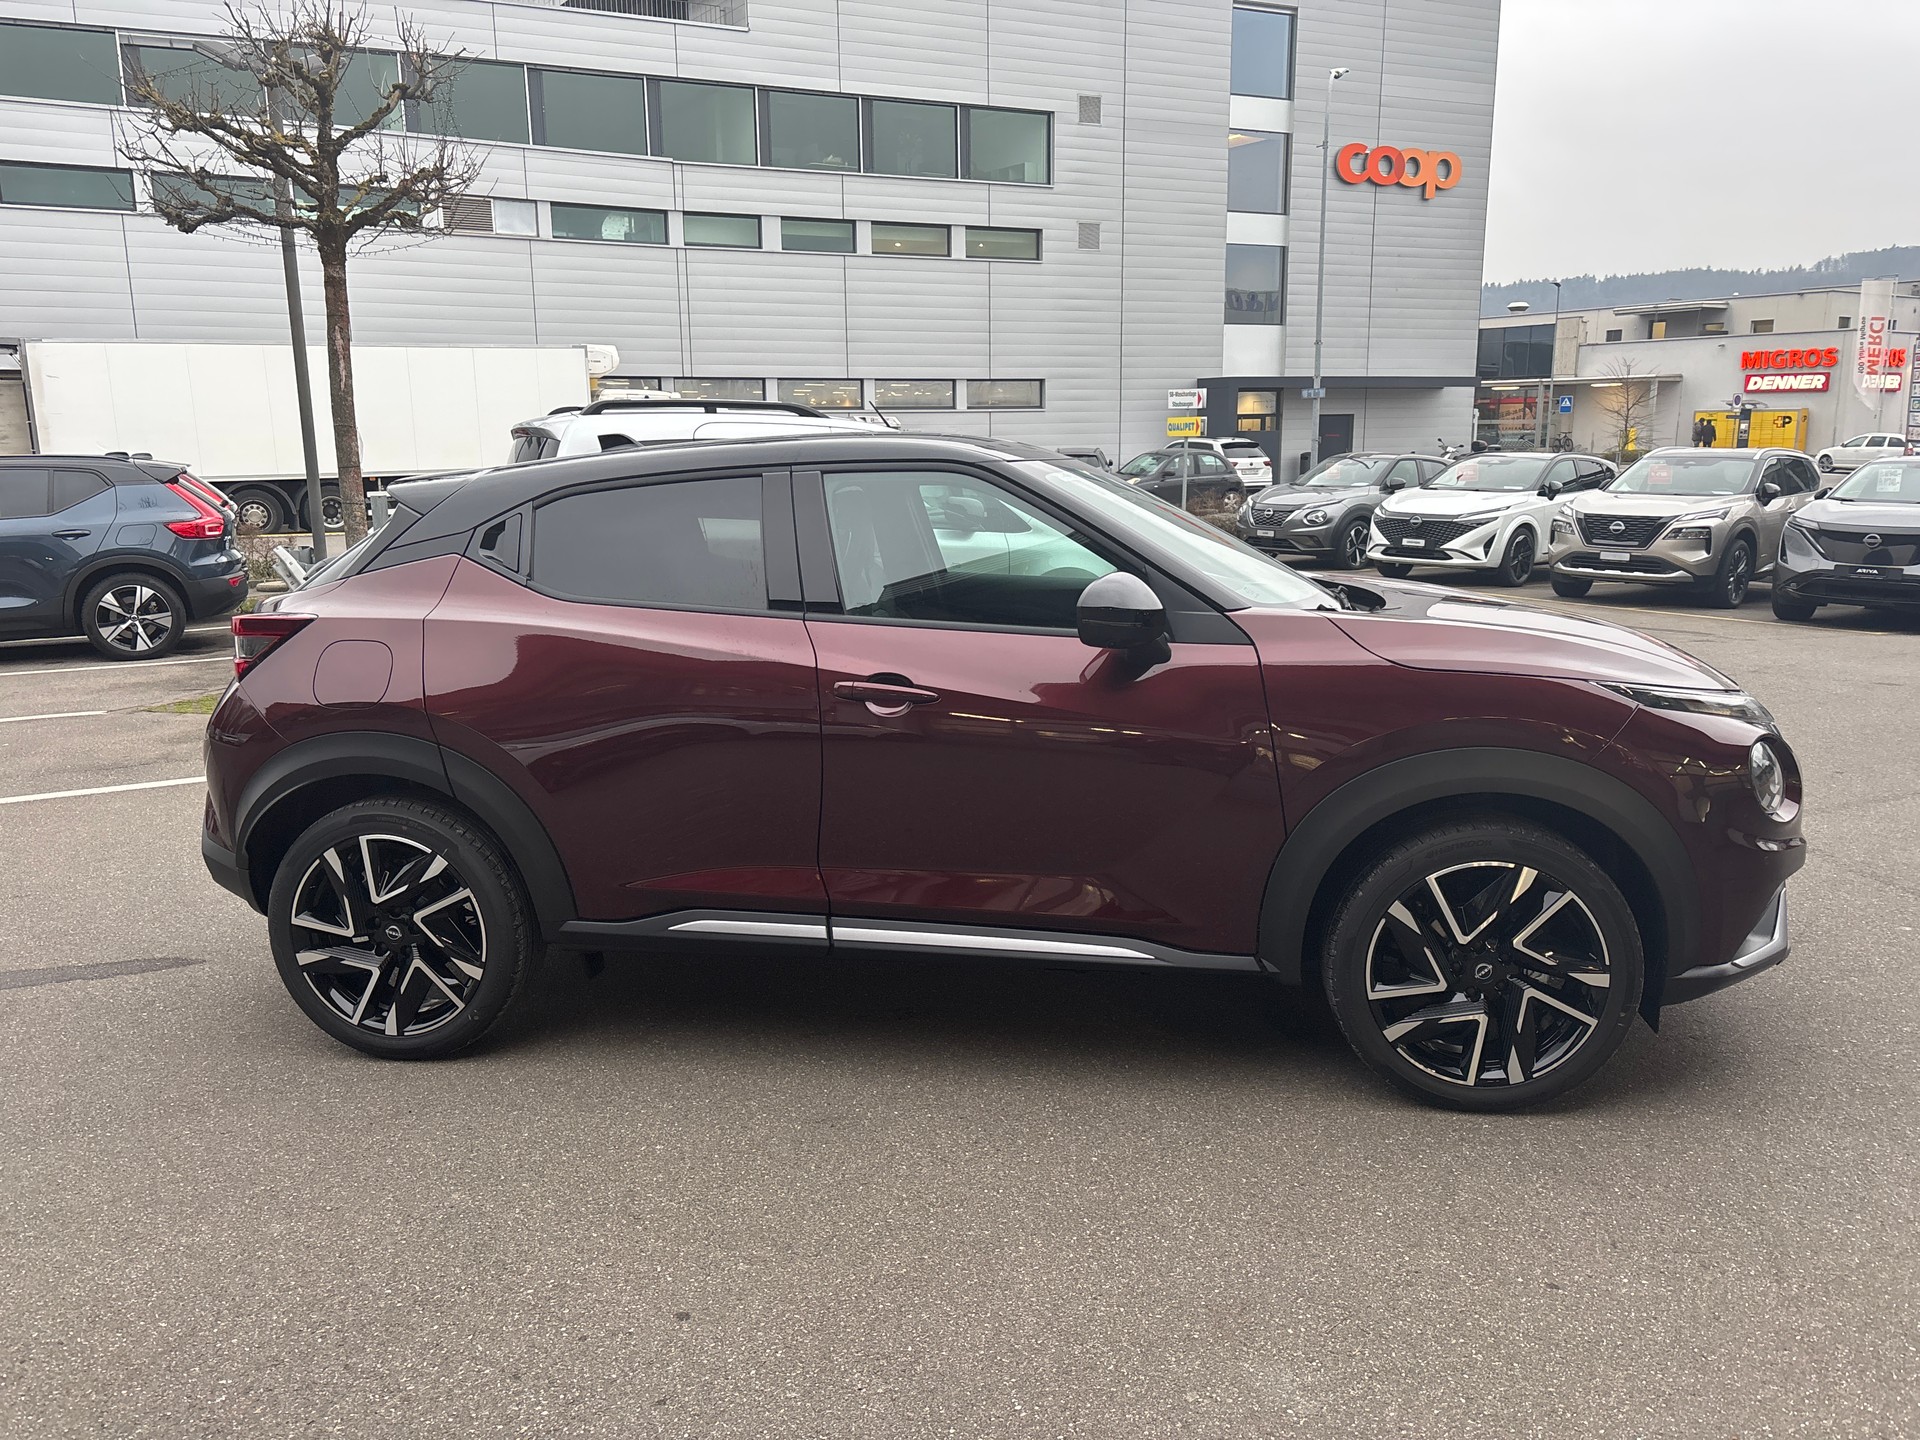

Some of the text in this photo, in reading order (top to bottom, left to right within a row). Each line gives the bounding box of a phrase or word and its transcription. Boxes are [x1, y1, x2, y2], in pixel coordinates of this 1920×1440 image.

[1336, 142, 1462, 199] coop
[1741, 347, 1838, 369] MIGROS
[1746, 374, 1826, 390] DENNER
[1168, 422, 1195, 431] QUALIPET
